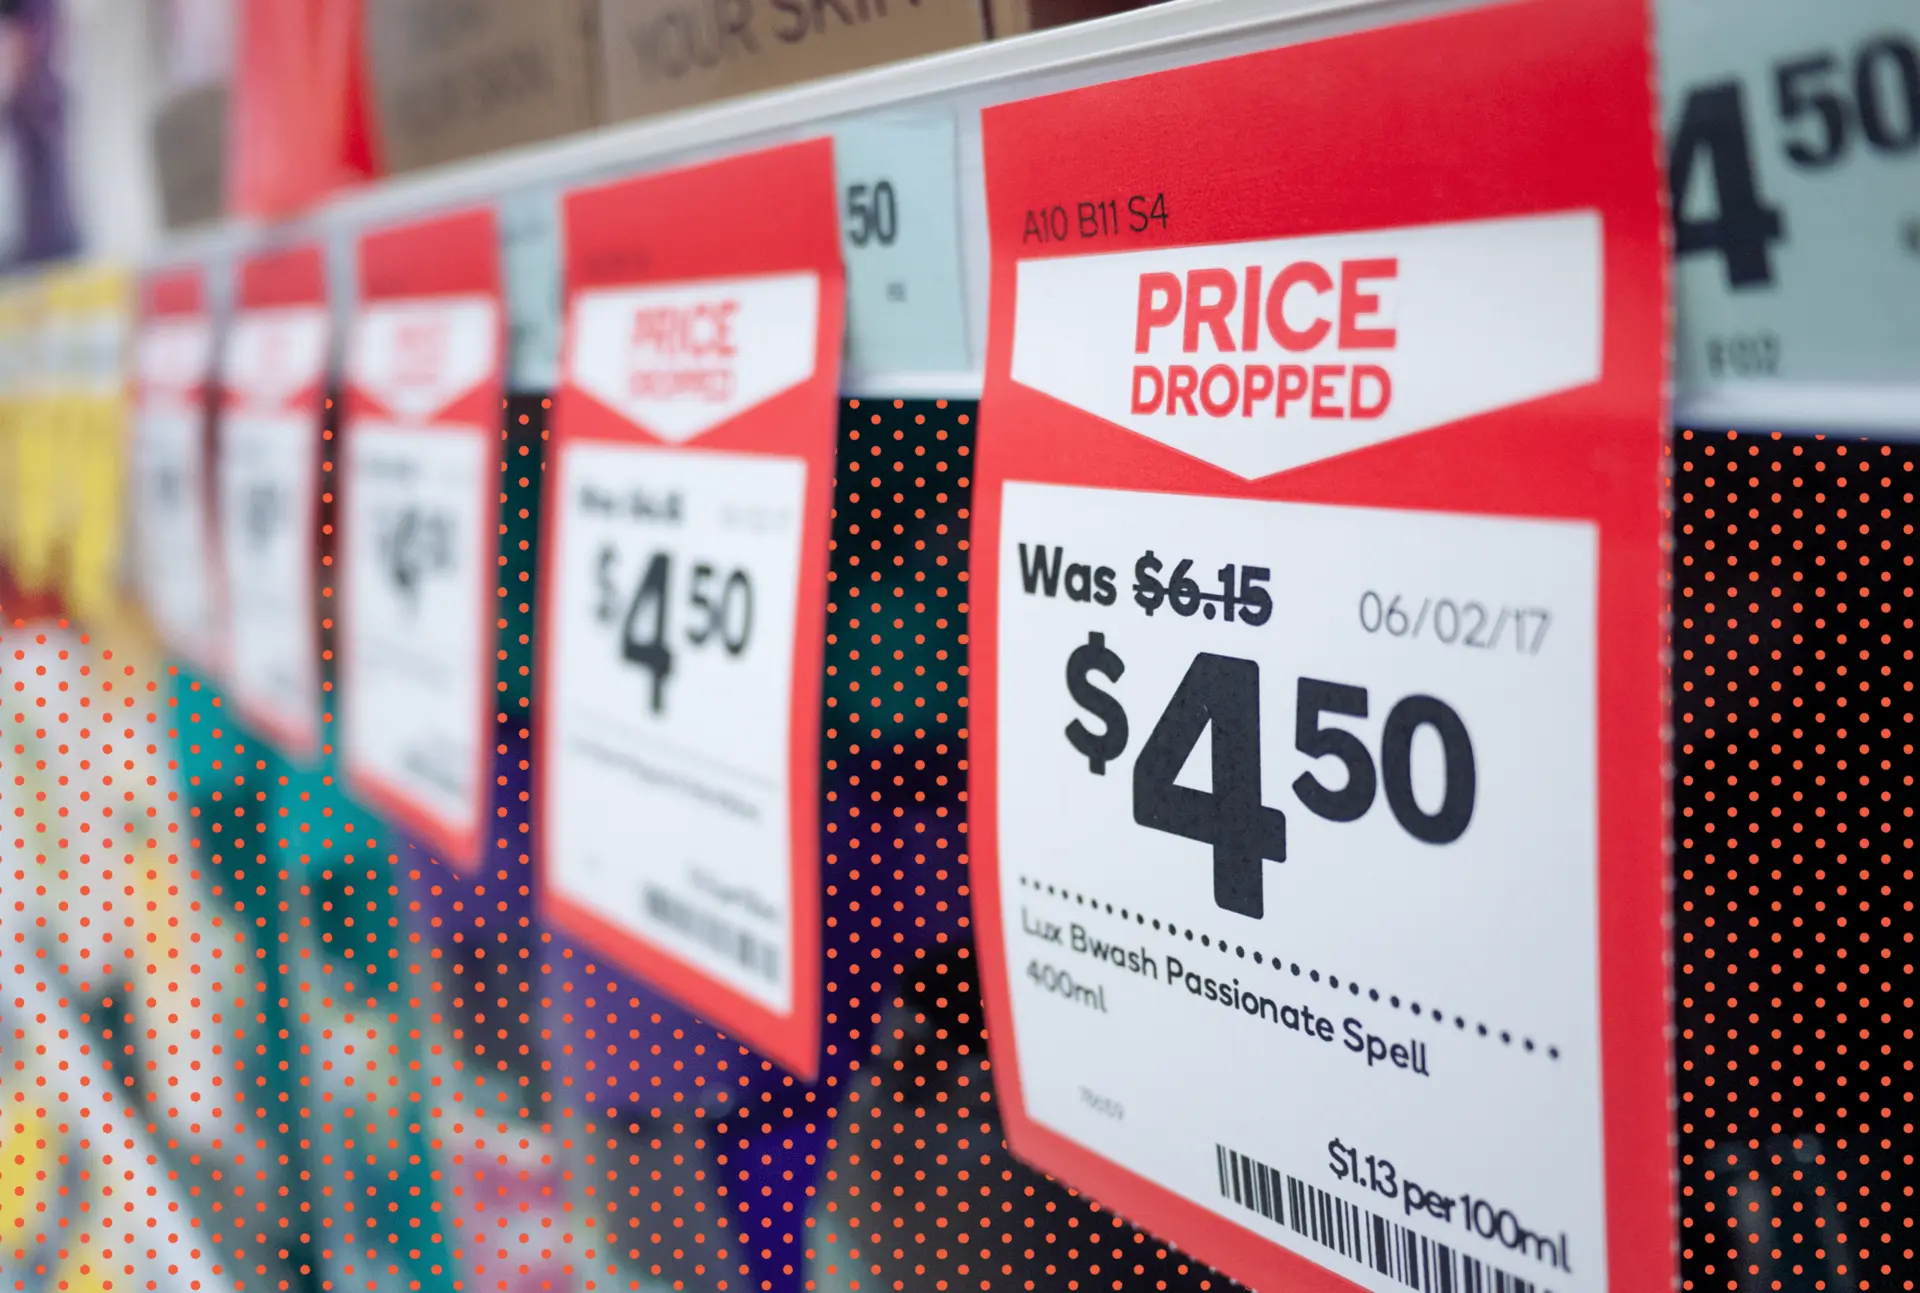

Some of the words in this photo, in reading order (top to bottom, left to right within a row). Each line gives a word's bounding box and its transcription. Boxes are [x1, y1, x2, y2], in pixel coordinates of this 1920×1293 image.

[848, 180, 897, 248] 50
[1022, 206, 1068, 244] A10
[1078, 200, 1119, 239] B11
[1128, 192, 1169, 233] S4
[631, 299, 741, 357] PRICE
[1134, 257, 1399, 354] PRICE
[1130, 364, 1394, 421] DROPPED
[1018, 543, 1118, 606] Was
[1132, 550, 1274, 626] $6.15
[1358, 590, 1553, 656] 06/02/17
[1020, 904, 1064, 946] Lux
[1069, 922, 1158, 980] Bwash
[1166, 955, 1335, 1042] Passionate
[1342, 1016, 1430, 1078] Spell
[1025, 958, 1108, 1014] 400ml
[1327, 1136, 1399, 1199] $1.13
[1402, 1178, 1456, 1223] per
[1458, 1192, 1573, 1275] 100ml
